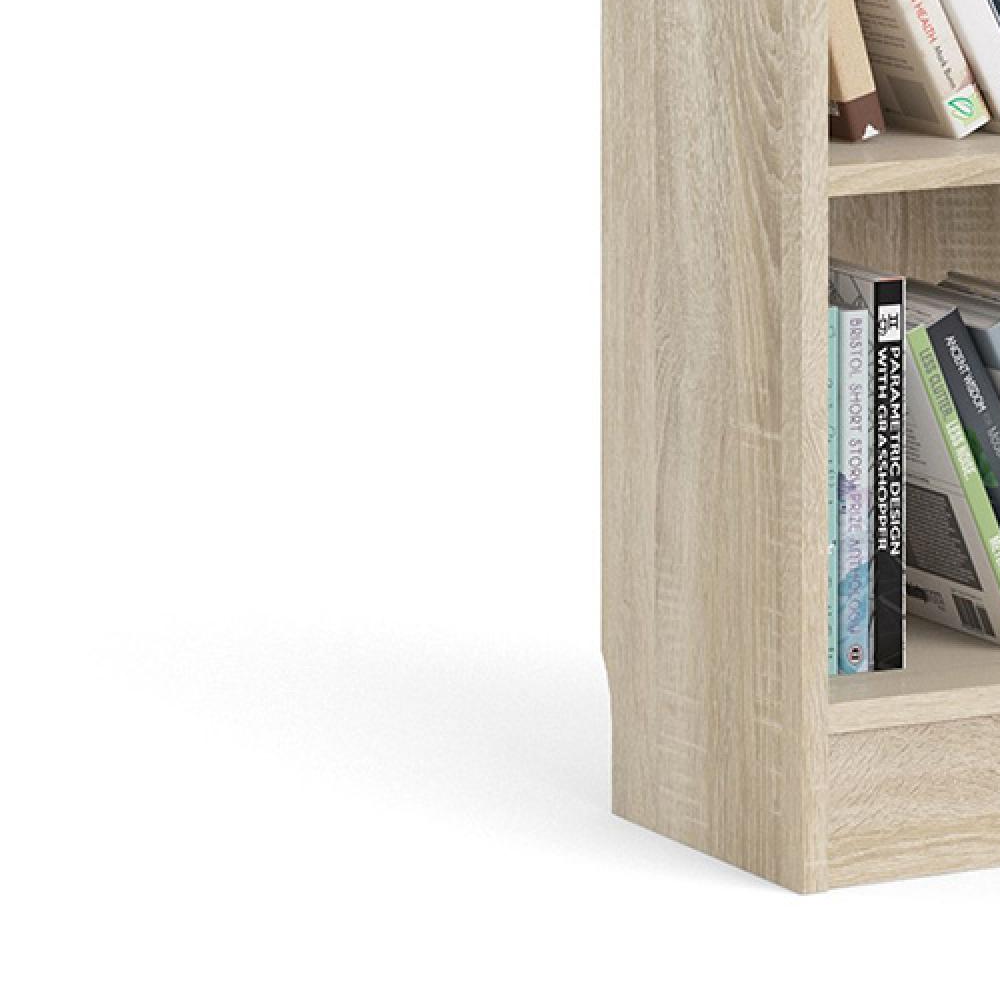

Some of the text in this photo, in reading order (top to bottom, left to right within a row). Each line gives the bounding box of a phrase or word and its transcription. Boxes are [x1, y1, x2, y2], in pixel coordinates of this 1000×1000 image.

[914, 2, 937, 44] HEALTH
[919, 347, 937, 371] LESS
[946, 336, 970, 374] ANCIENT
[964, 374, 986, 412] WISDOM
[848, 317, 863, 634] BRISTOL SHORT STORY PRIZE ANTHOLOGY
[877, 347, 888, 551] WITH GRASSHOPPER
[889, 347, 901, 555] PARAMETRIC DESIGN
